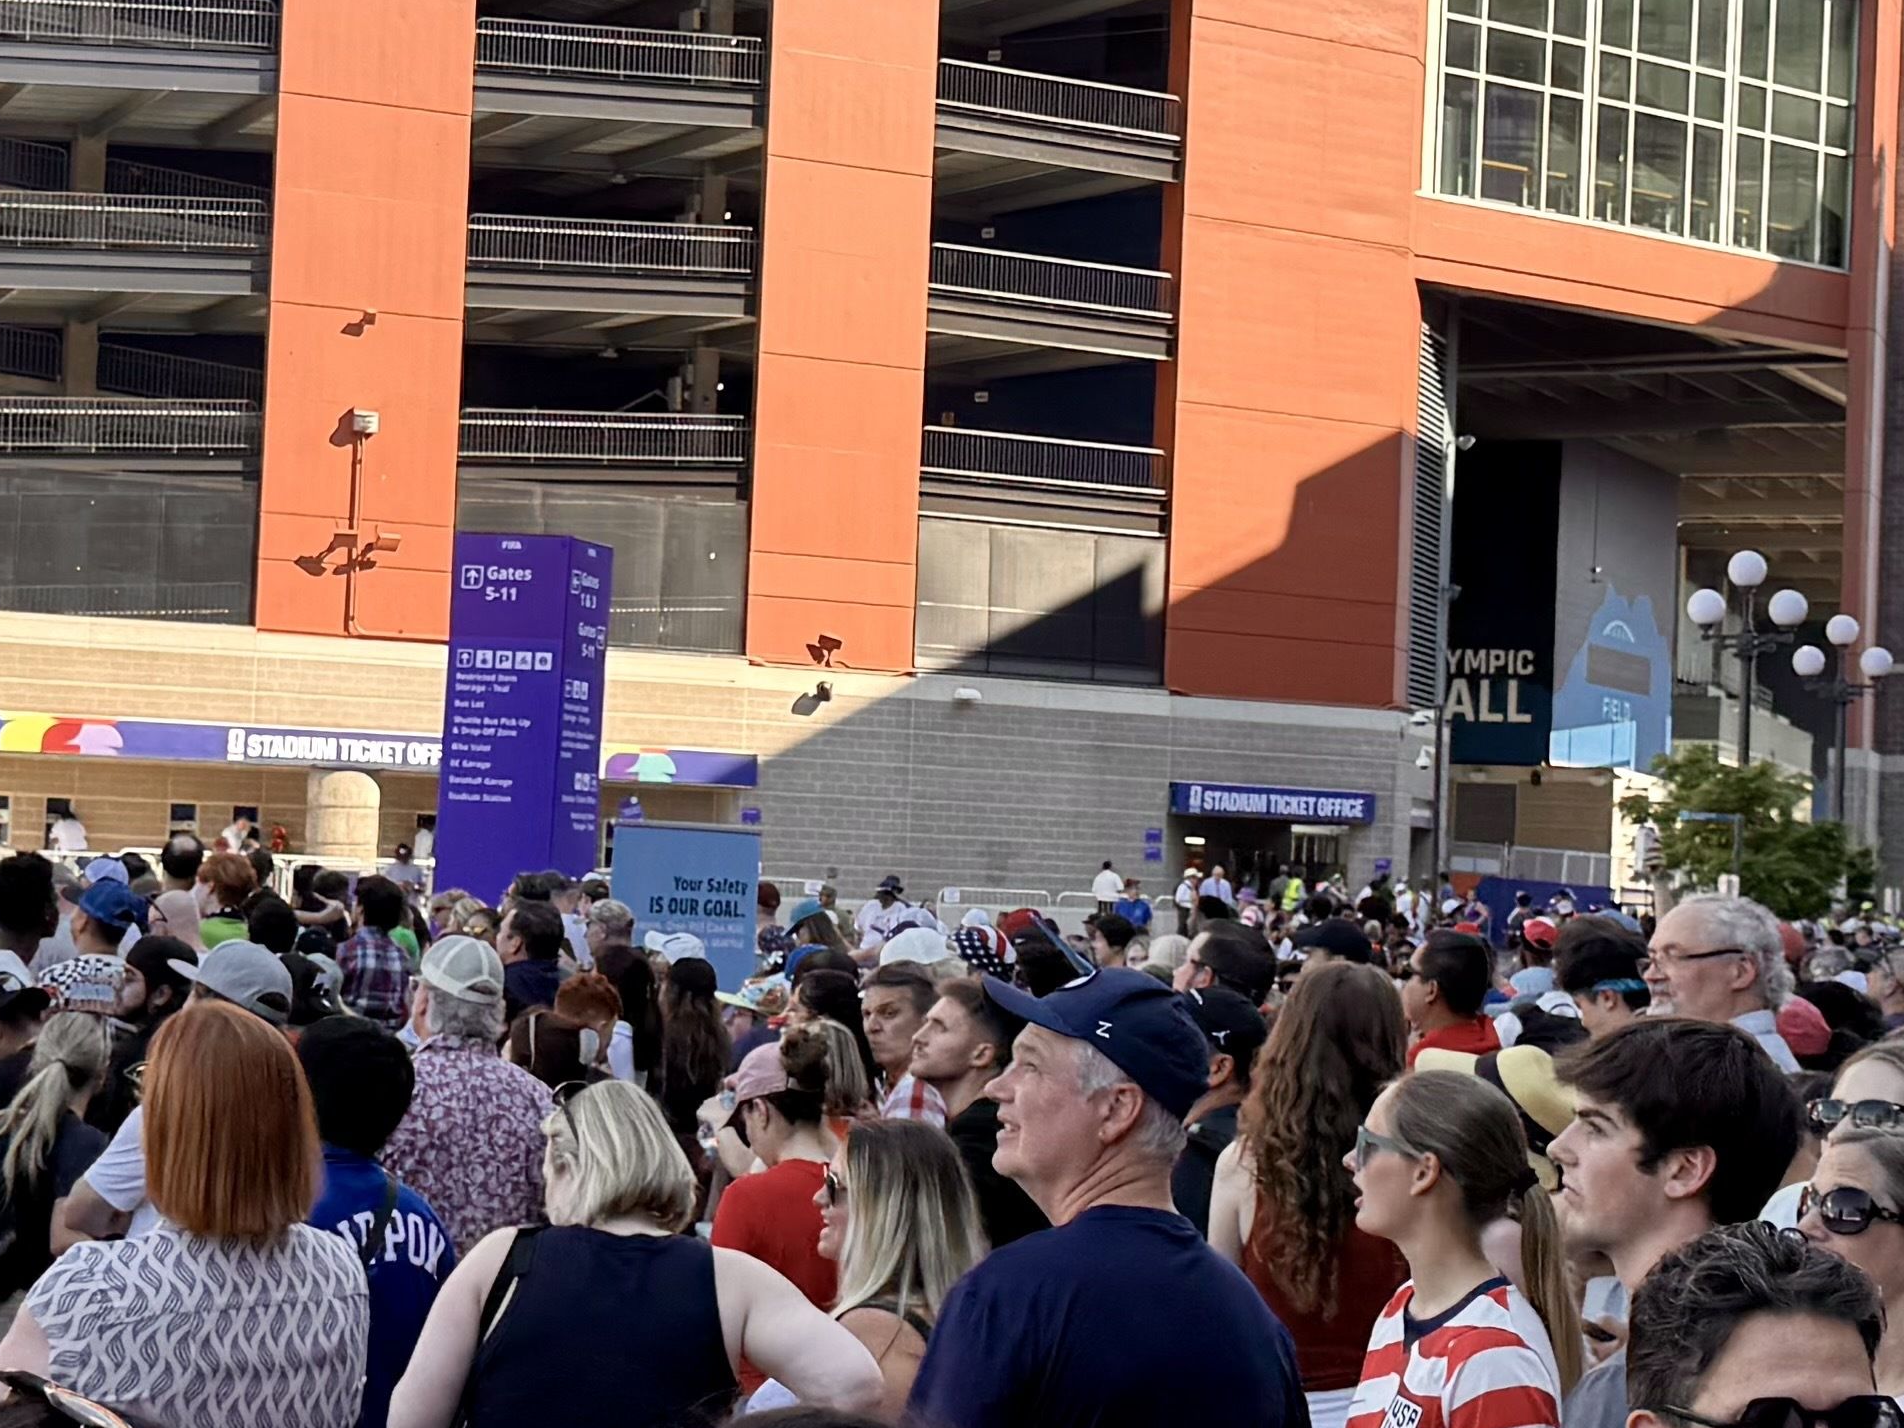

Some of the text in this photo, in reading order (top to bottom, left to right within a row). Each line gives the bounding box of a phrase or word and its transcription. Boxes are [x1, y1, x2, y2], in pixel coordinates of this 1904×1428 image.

[487, 566, 532, 581] Gates
[485, 587, 517, 601] 5-11
[1447, 648, 1535, 676] YMPIC
[1444, 678, 1532, 722] ALL
[247, 734, 443, 766] STADIUM TICKET OFF
[1204, 791, 1364, 818] STADIUM TICKET OFFICE
[673, 876, 748, 896] Your Safety
[649, 896, 745, 918] IS OUR GOAL.
[1392, 1399, 1419, 1428] USA
